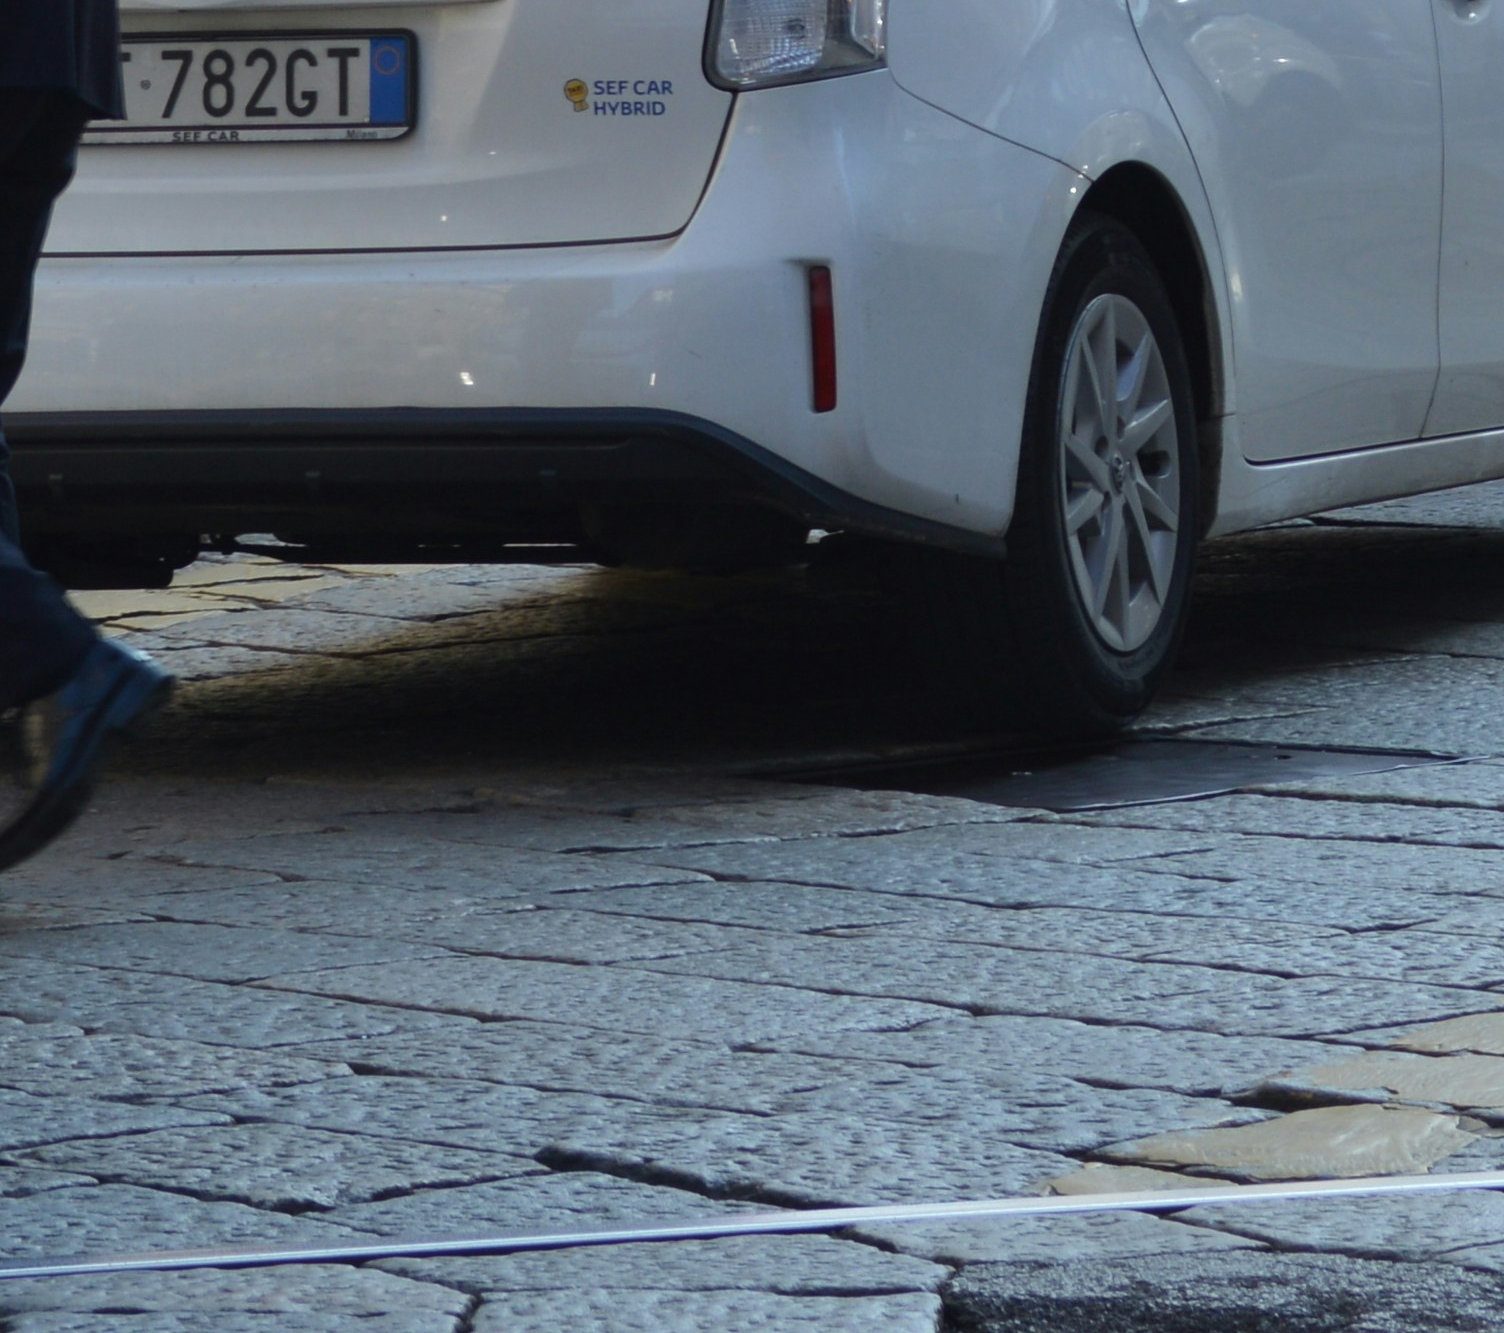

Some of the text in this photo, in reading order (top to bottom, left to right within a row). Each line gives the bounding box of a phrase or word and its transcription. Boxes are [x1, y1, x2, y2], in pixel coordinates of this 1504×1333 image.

[160, 47, 361, 119] 782GT
[593, 80, 673, 95] SEF CAR
[593, 101, 666, 116] HYBRID
[172, 129, 240, 143] SEF CAR
